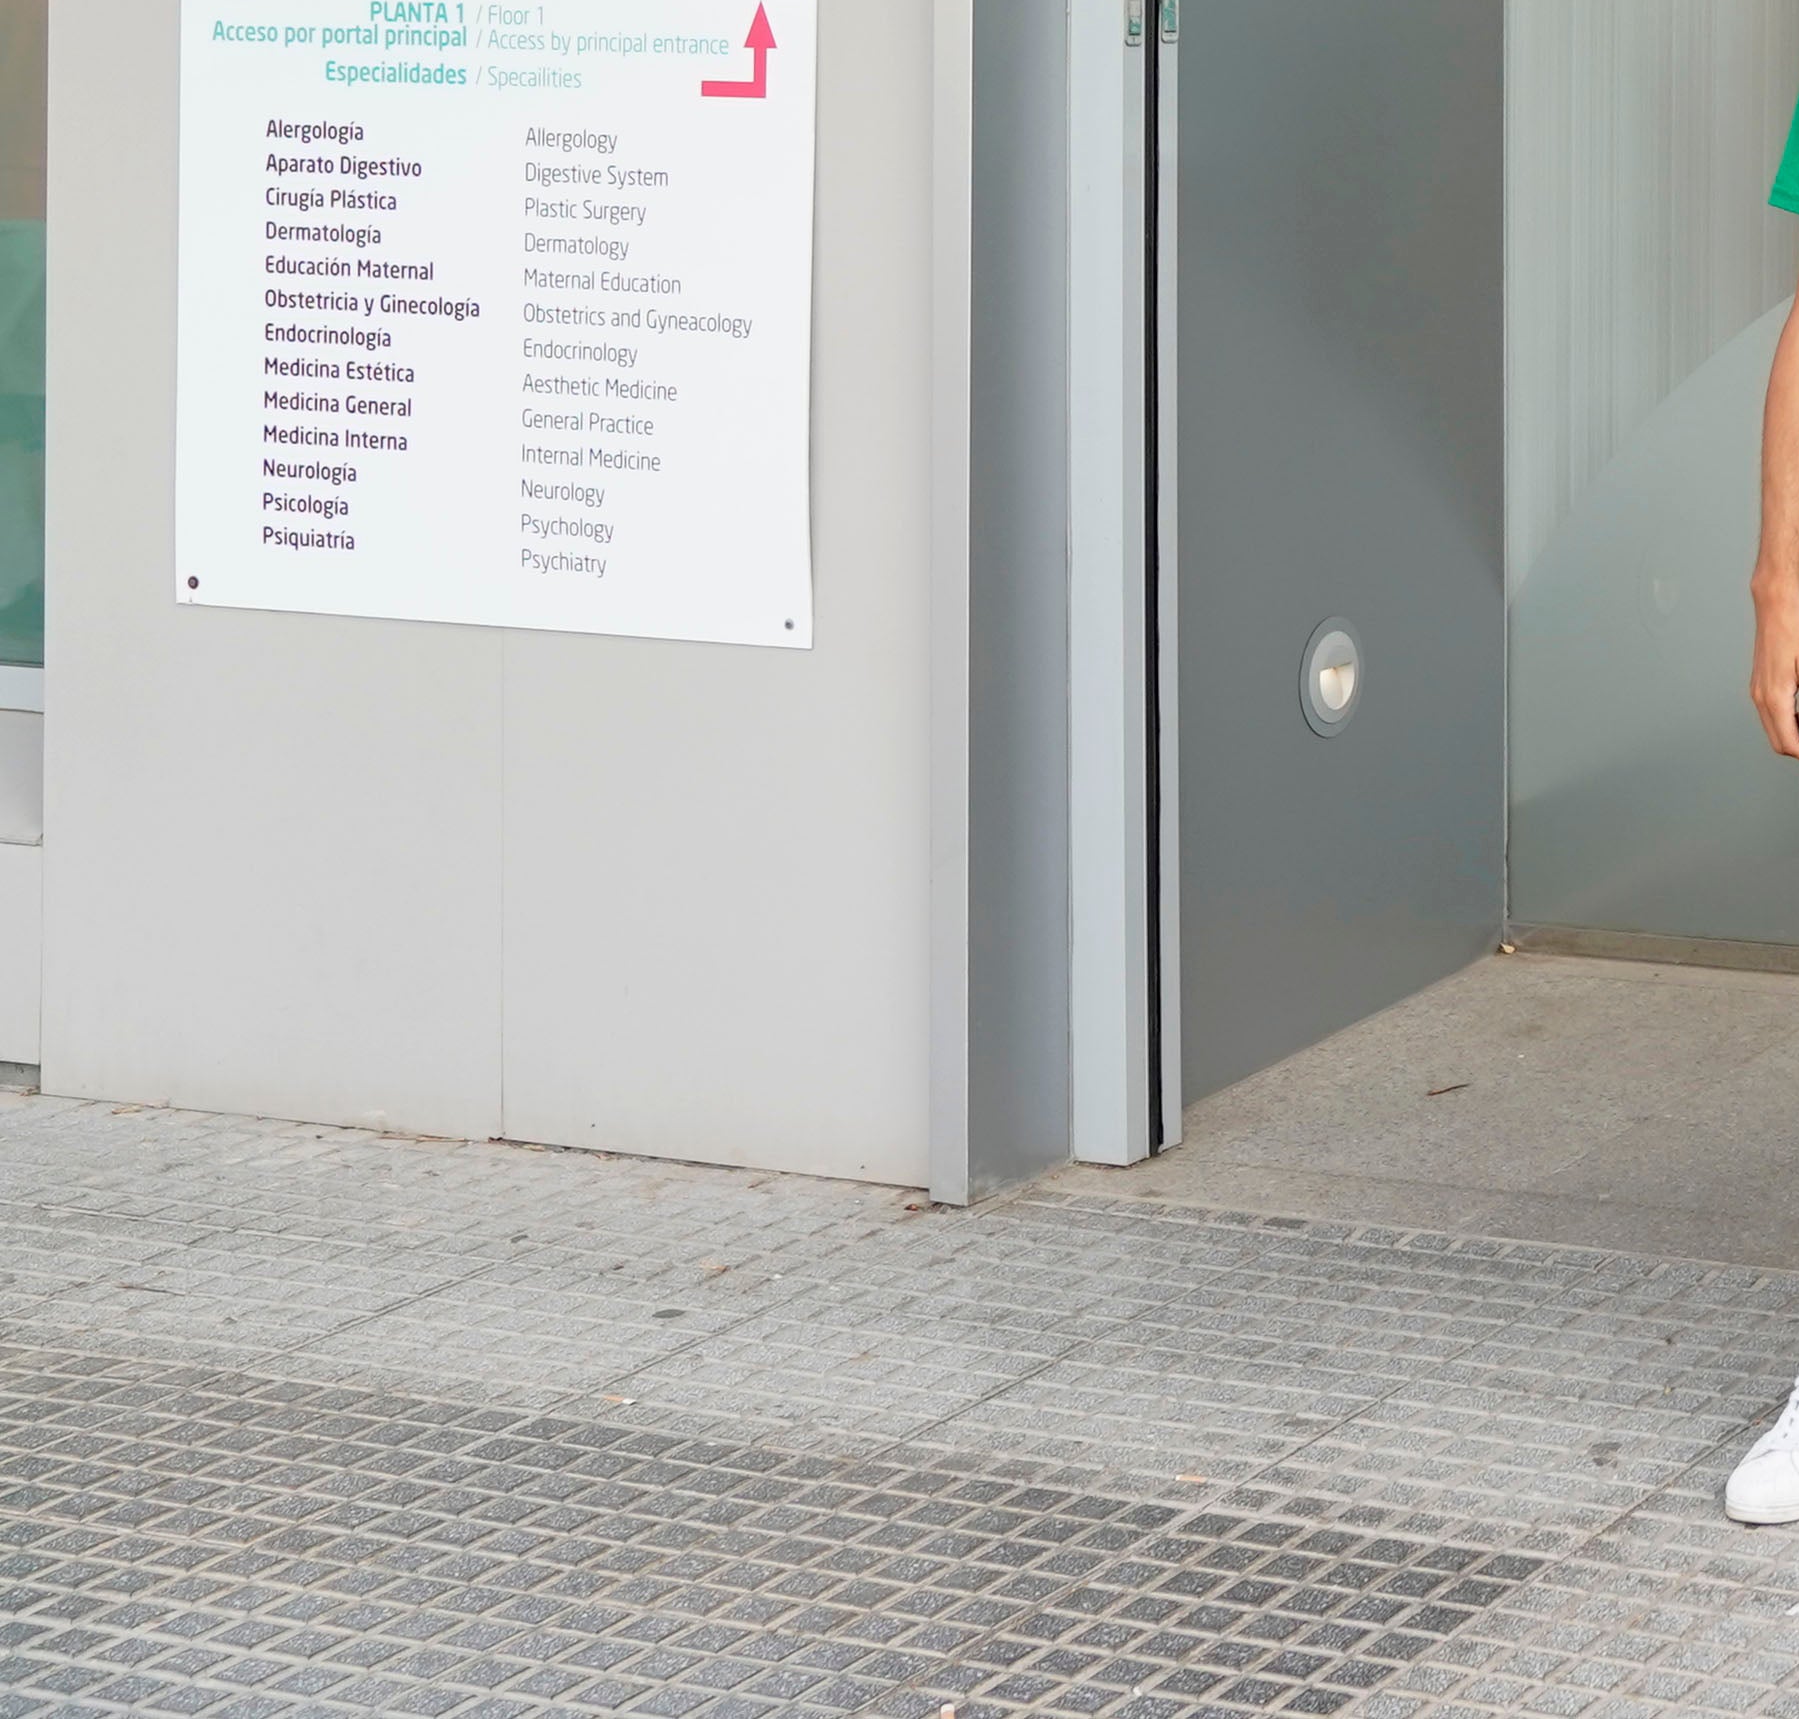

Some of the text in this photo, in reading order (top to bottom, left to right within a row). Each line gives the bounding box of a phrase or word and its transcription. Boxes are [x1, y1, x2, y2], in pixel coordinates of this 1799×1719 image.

[370, 1, 543, 25] PLANTA 1 Floor 1
[213, 20, 729, 56] Acceso por portal principal Access by principal entrance
[326, 60, 582, 90] Especialidades Specailities
[266, 119, 363, 145] Alergología
[525, 127, 617, 154] Allergology
[266, 154, 421, 180] Aparato Digestivo
[526, 162, 668, 190] Digestive System
[266, 187, 396, 211] Cirugía Plástica
[525, 197, 646, 226] Plastic Surgery
[266, 221, 381, 248] Dermatología
[525, 233, 629, 261] Dermatology
[266, 255, 433, 280] Educación Maternal
[524, 268, 681, 294] Maternal Education
[265, 289, 479, 321] Obstetricia y Ginecología
[524, 303, 752, 338] Obstetrics and Gyneacology
[265, 323, 391, 351] Endocrinología
[524, 338, 638, 368] Endocrinology
[265, 357, 414, 382] Medicina Estética
[523, 373, 677, 401] Aesthetic Medicine
[264, 391, 411, 416] Medicina General
[522, 408, 653, 435] General Practice
[264, 425, 407, 450] Medicina Interna
[522, 444, 660, 471] Internal Medicine
[263, 459, 356, 486] Neurología
[263, 492, 348, 519] Psicología
[522, 479, 605, 507] Neurology
[263, 526, 354, 550] Psiquiatría
[521, 514, 614, 543] Psychology
[522, 549, 606, 578] Psychiatry
